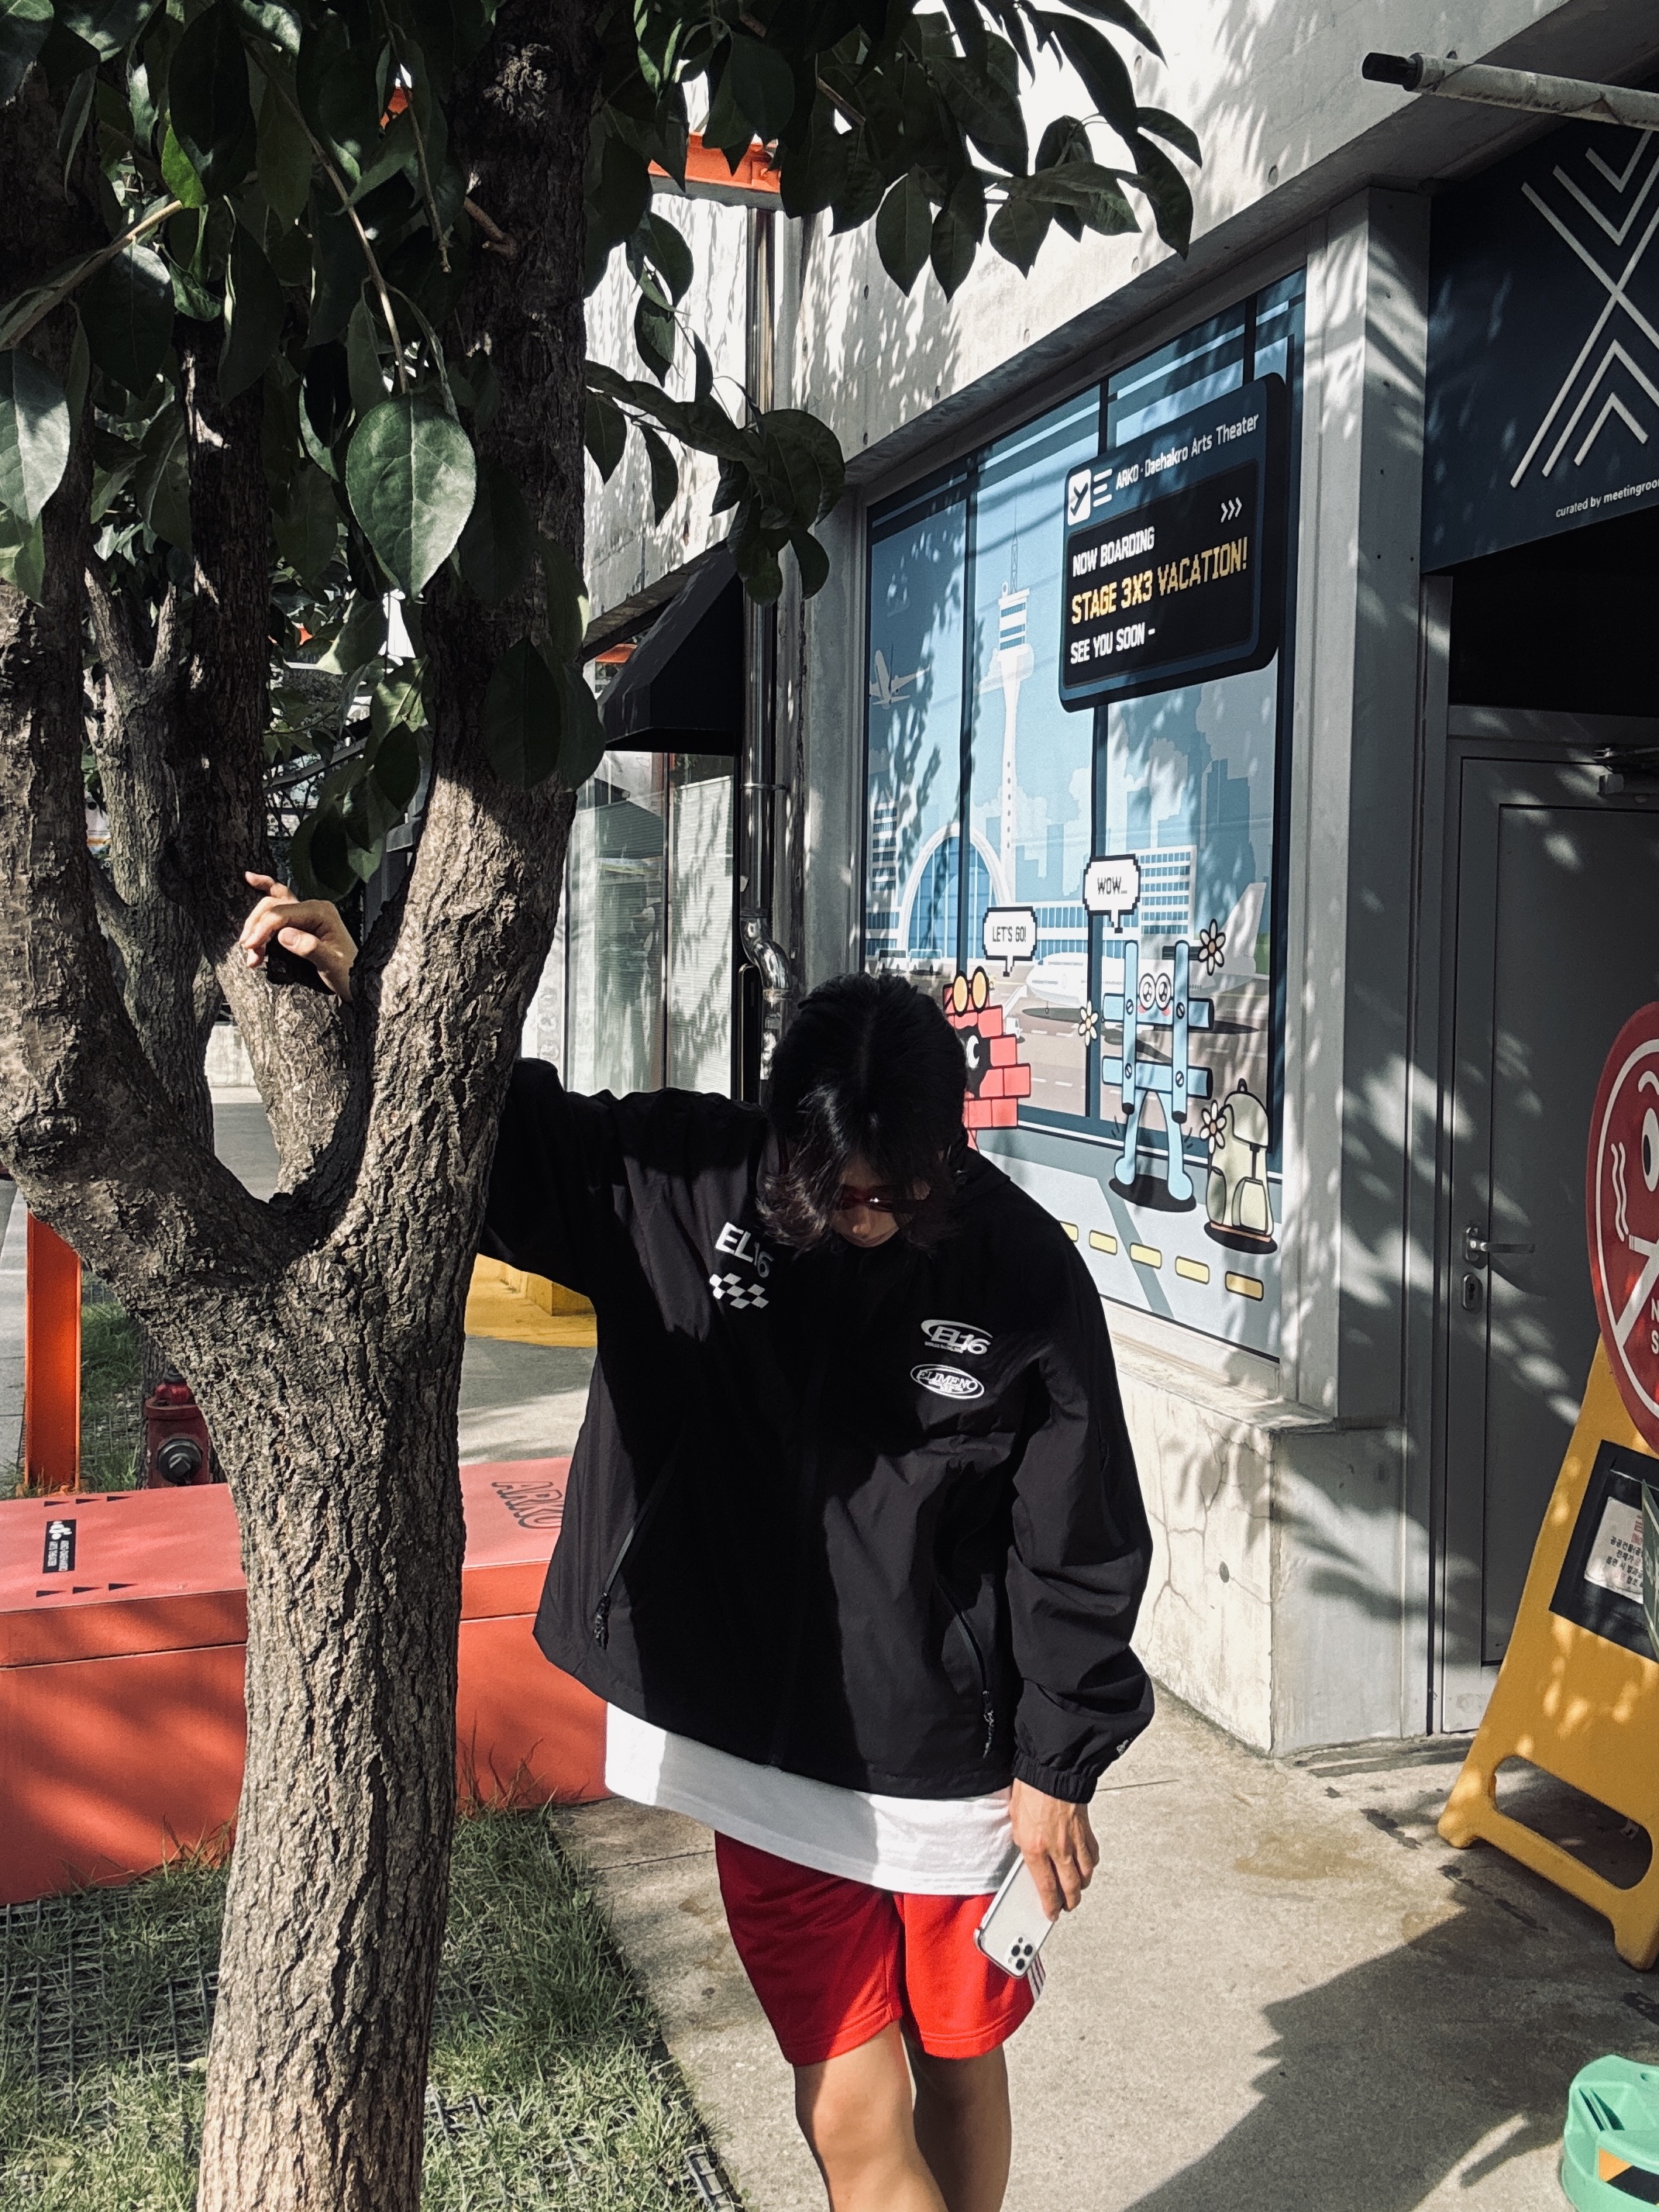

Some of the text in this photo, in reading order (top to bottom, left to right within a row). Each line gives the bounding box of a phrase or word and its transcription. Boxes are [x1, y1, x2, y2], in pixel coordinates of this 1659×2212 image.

[1116, 413, 1260, 491] ARKO Daehakro Arts Theater
[1555, 498, 1588, 518] curated
[1590, 495, 1602, 508] by
[1072, 525, 1155, 577] NOW BOARDING
[1071, 536, 1248, 625] STAGE 3X3 VACATION!
[1070, 622, 1145, 664] SEE YOU SOON
[992, 926, 1027, 943] LET'S GO!
[715, 1221, 773, 1277] EL16
[931, 1325, 992, 1355] EL16
